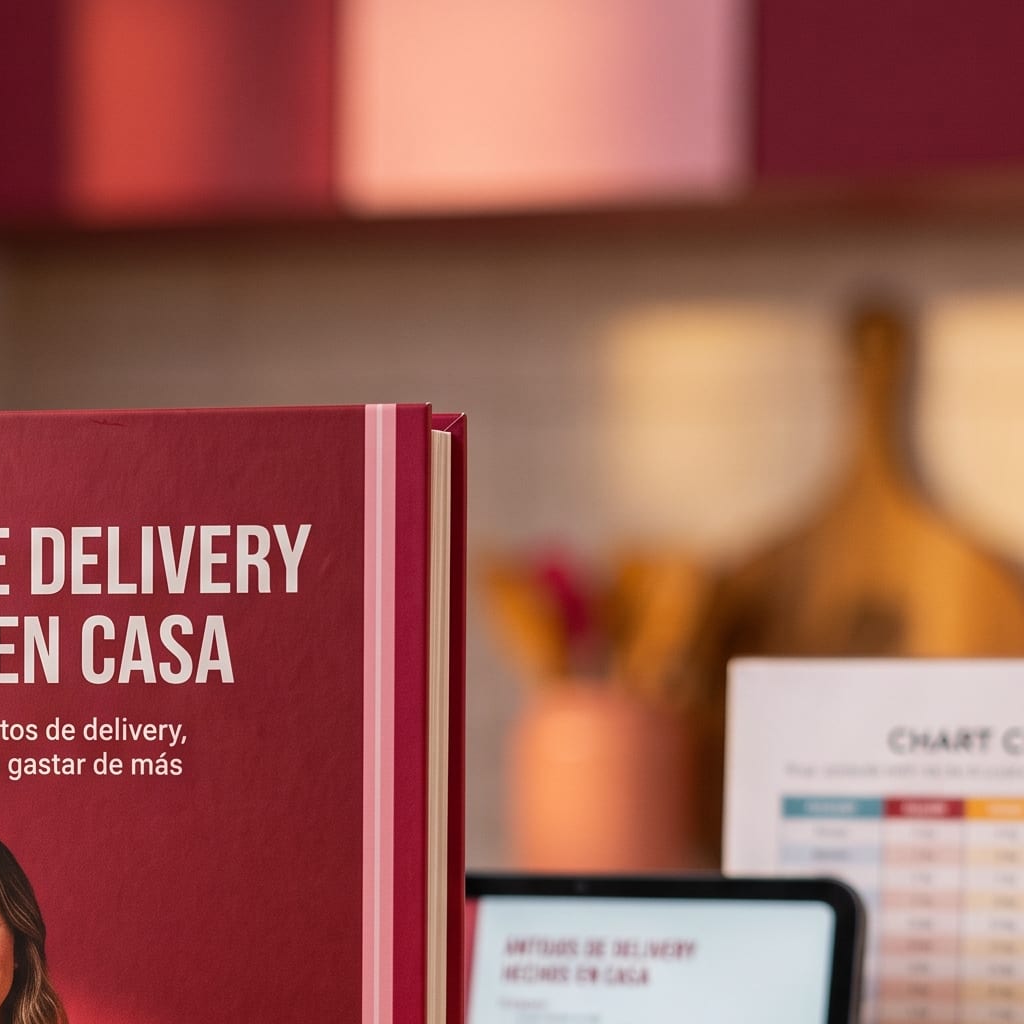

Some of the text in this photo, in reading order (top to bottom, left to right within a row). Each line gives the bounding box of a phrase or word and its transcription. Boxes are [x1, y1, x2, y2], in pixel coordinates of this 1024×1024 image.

[30, 524, 312, 595] DELIVERY
[81, 614, 235, 685] CASA
[45, 717, 76, 741] de
[83, 716, 187, 747] delivery,
[888, 727, 991, 754] CHART
[8, 754, 87, 781] gastar
[93, 751, 123, 776] de
[131, 751, 183, 776] más
